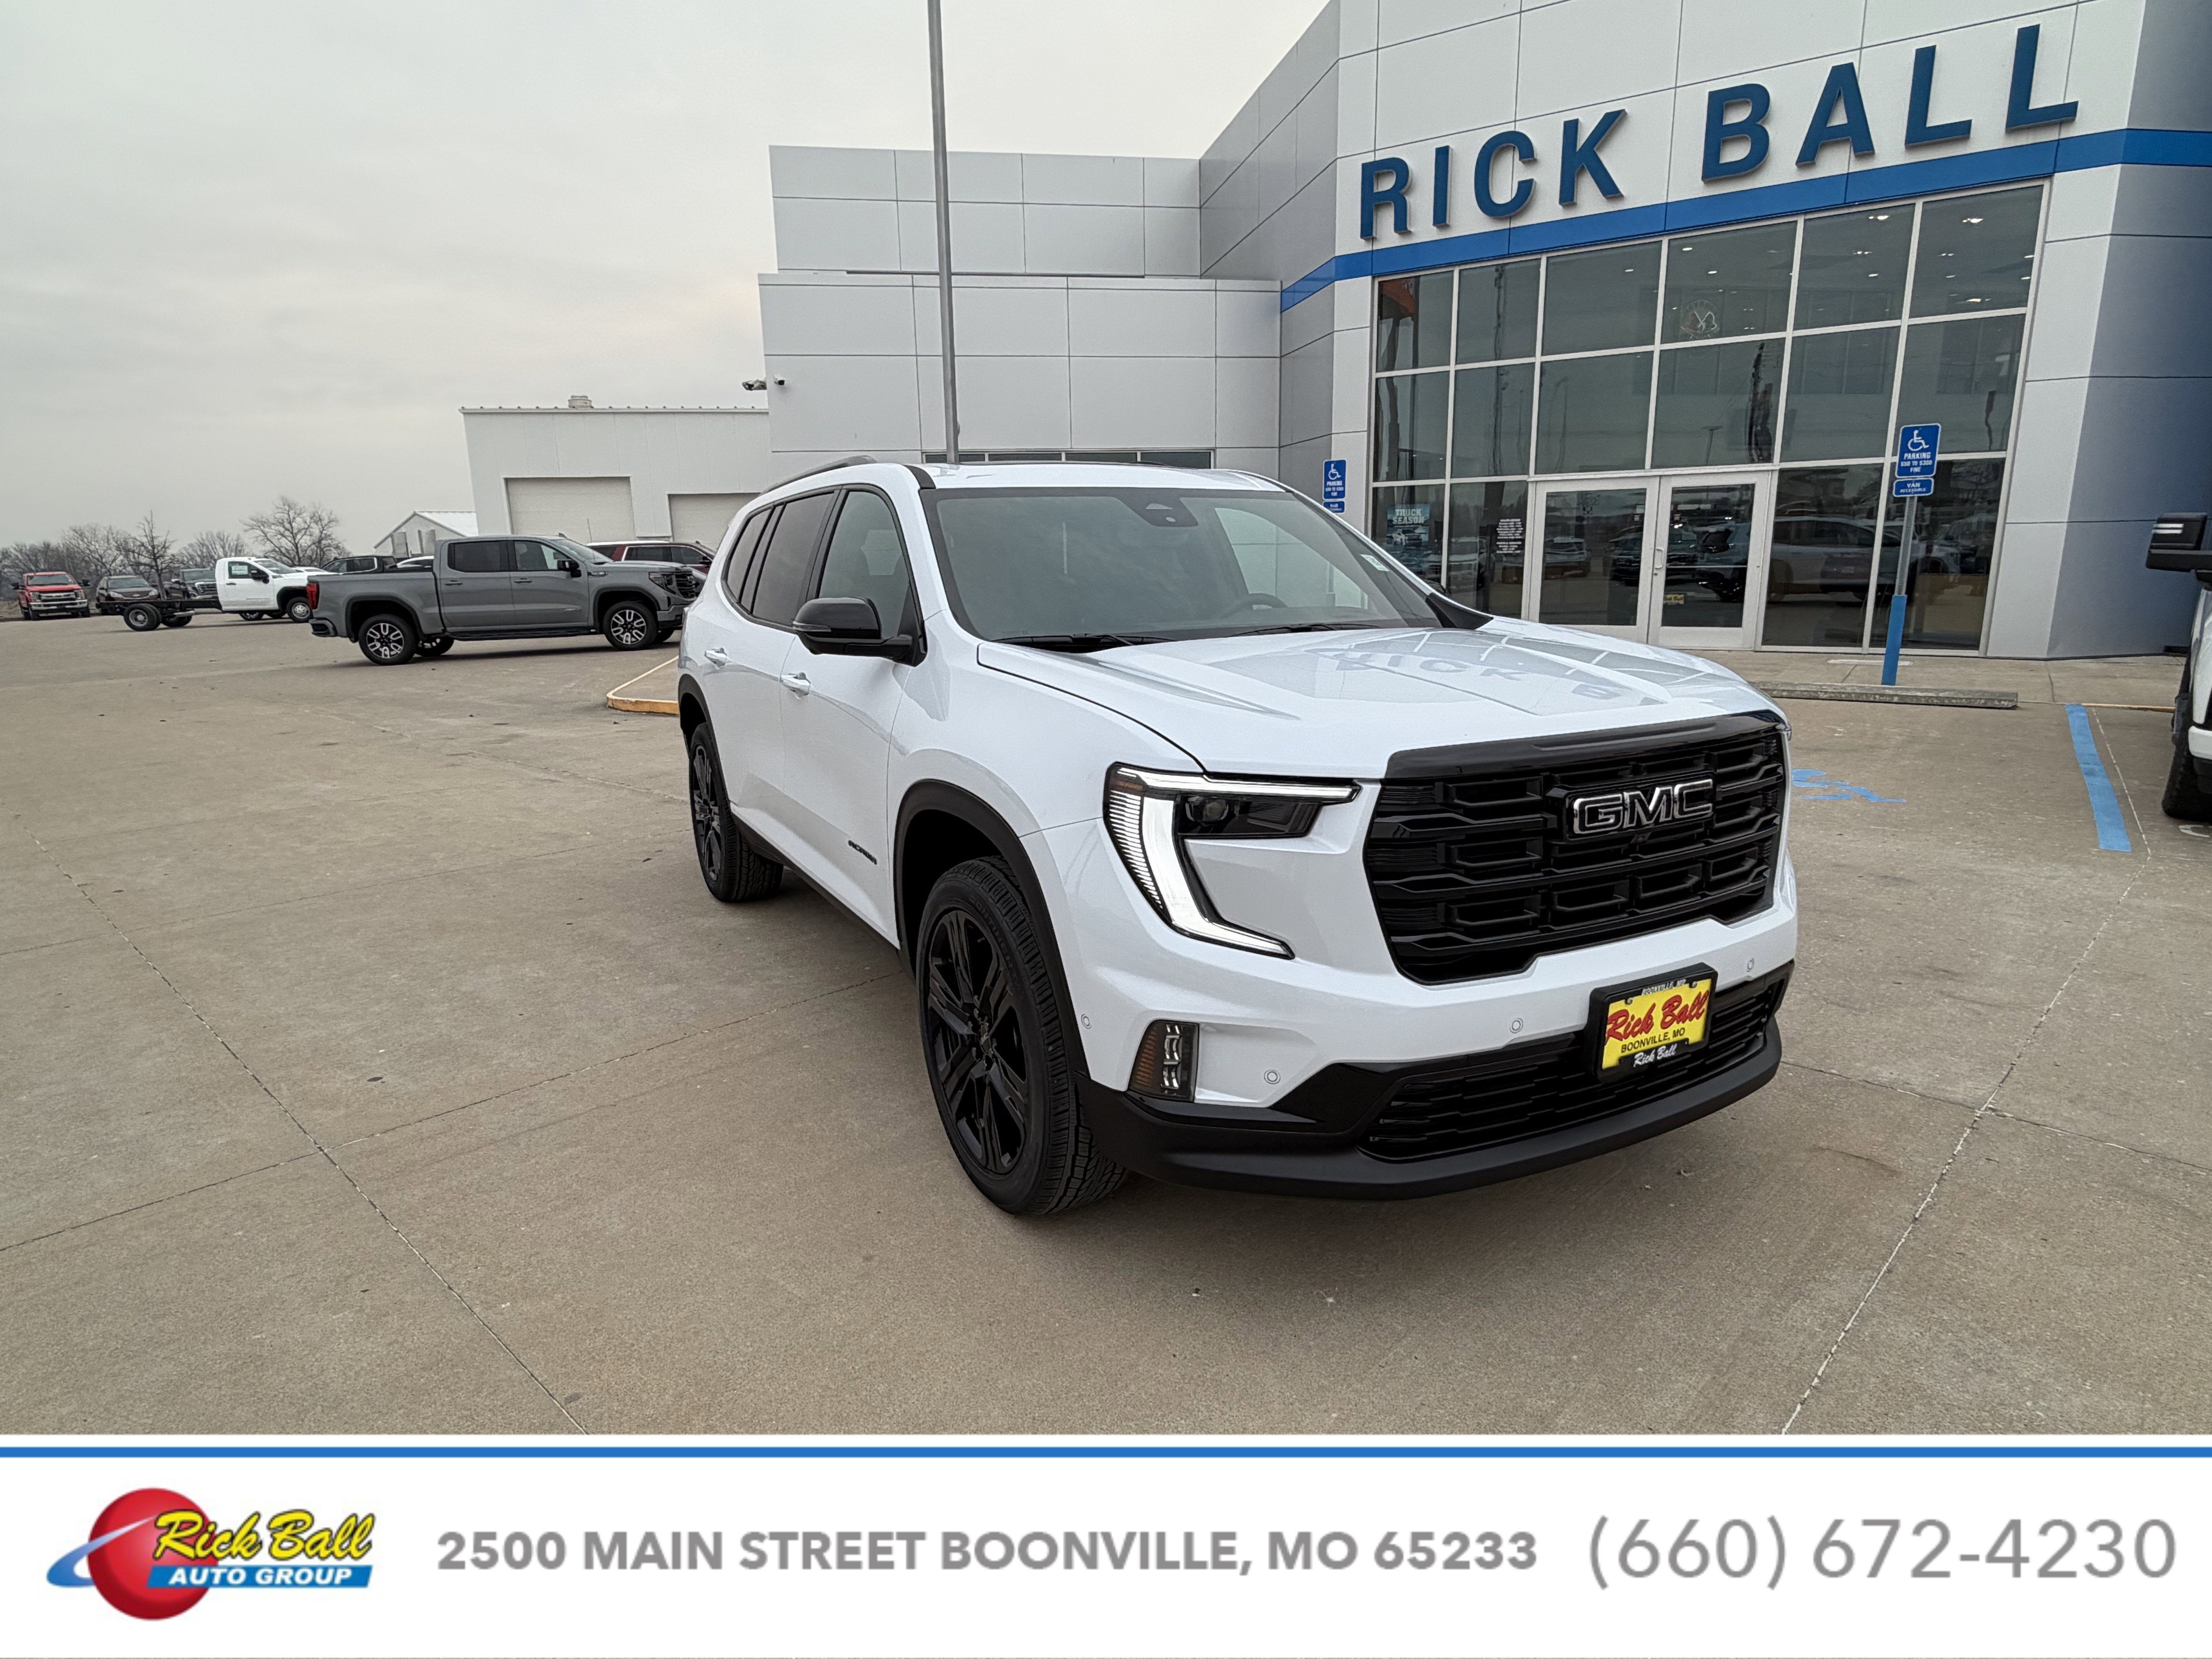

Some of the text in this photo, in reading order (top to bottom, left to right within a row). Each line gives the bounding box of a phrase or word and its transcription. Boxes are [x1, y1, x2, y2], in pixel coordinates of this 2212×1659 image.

[1360, 23, 2079, 241] RICK BALL
[1904, 452, 1931, 460] PARKING
[1393, 516, 1424, 524] SEASON
[1395, 508, 1422, 516] TRUCK
[1573, 779, 1713, 834] GMC
[1606, 990, 1710, 1043] Rick Ball
[1621, 1027, 1686, 1053] BOONVILLE, MO
[1633, 1043, 1678, 1067] Rick Ball
